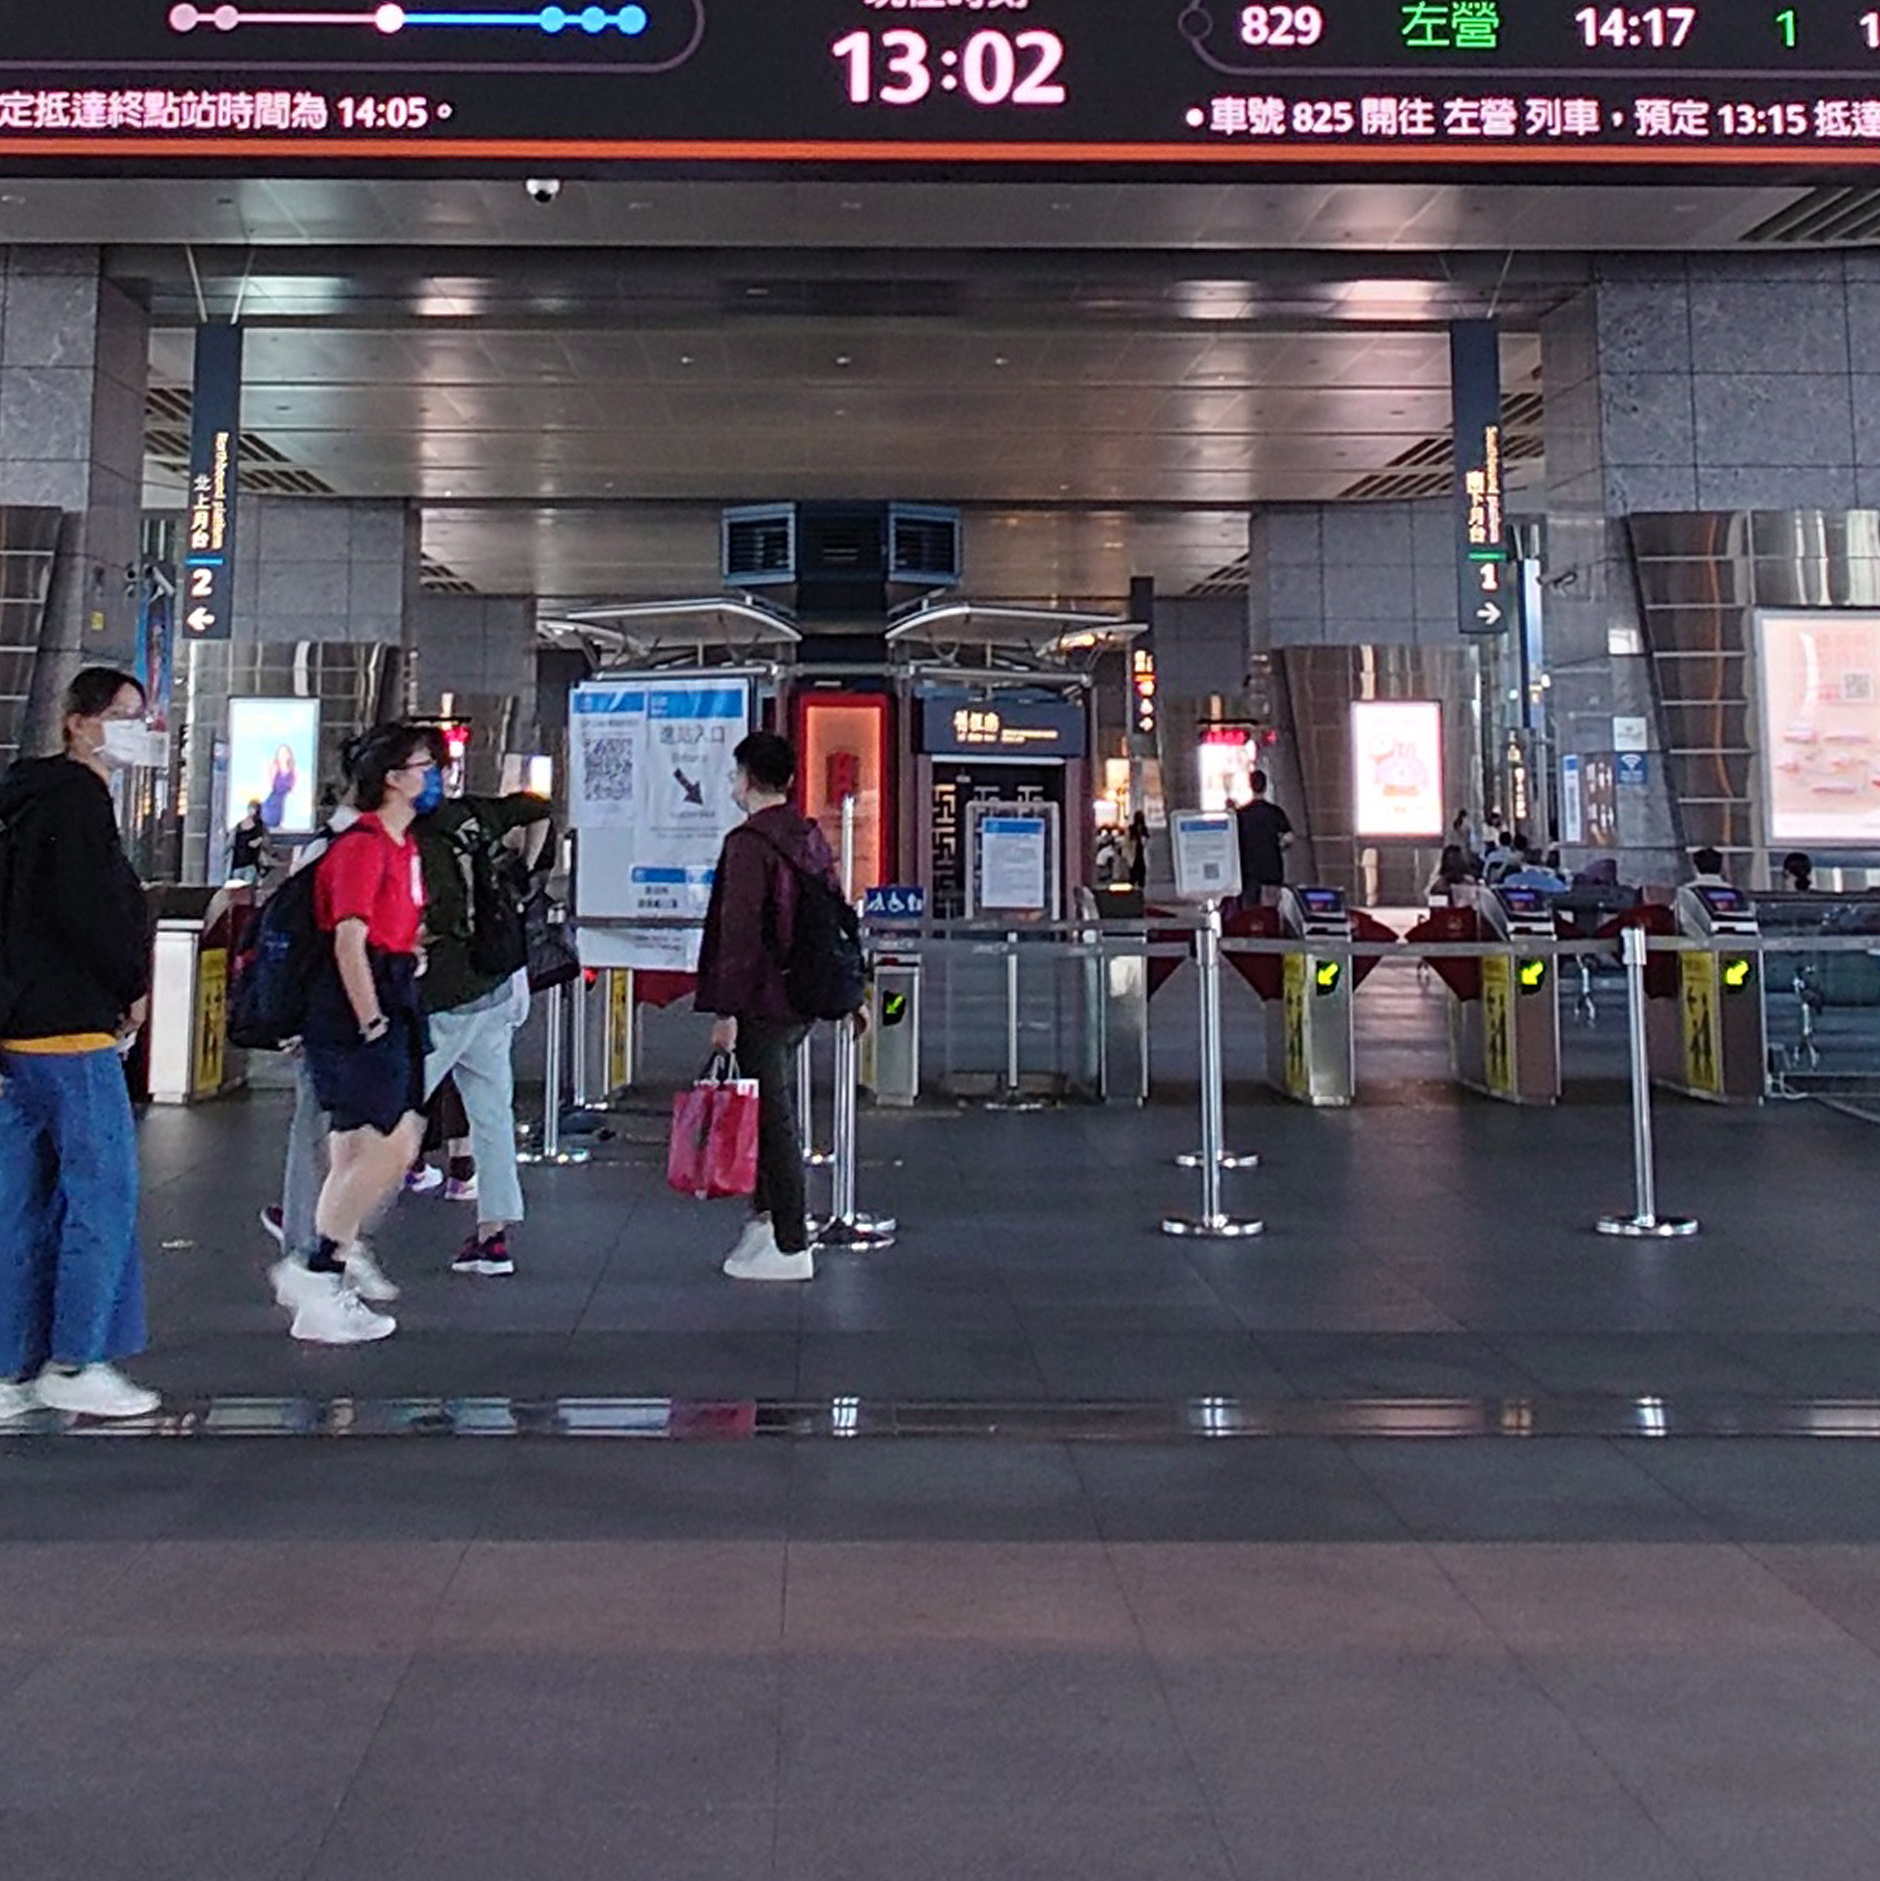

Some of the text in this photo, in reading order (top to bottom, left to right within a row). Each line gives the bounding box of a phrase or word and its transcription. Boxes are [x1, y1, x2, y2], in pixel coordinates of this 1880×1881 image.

[1240, 4, 1323, 46] 829
[1401, 0, 1500, 48] 左營
[1575, 6, 1696, 47] 14:17
[1776, 9, 1795, 47] 1
[832, 28, 1066, 105] 13:02
[1210, 95, 1287, 135] 車號
[1292, 101, 1355, 134] 825
[1360, 96, 1436, 136] 開往
[1443, 96, 1518, 136] 左營
[1717, 103, 1808, 135] 13:15
[191, 568, 213, 596] 2
[1480, 563, 1498, 590] 1
